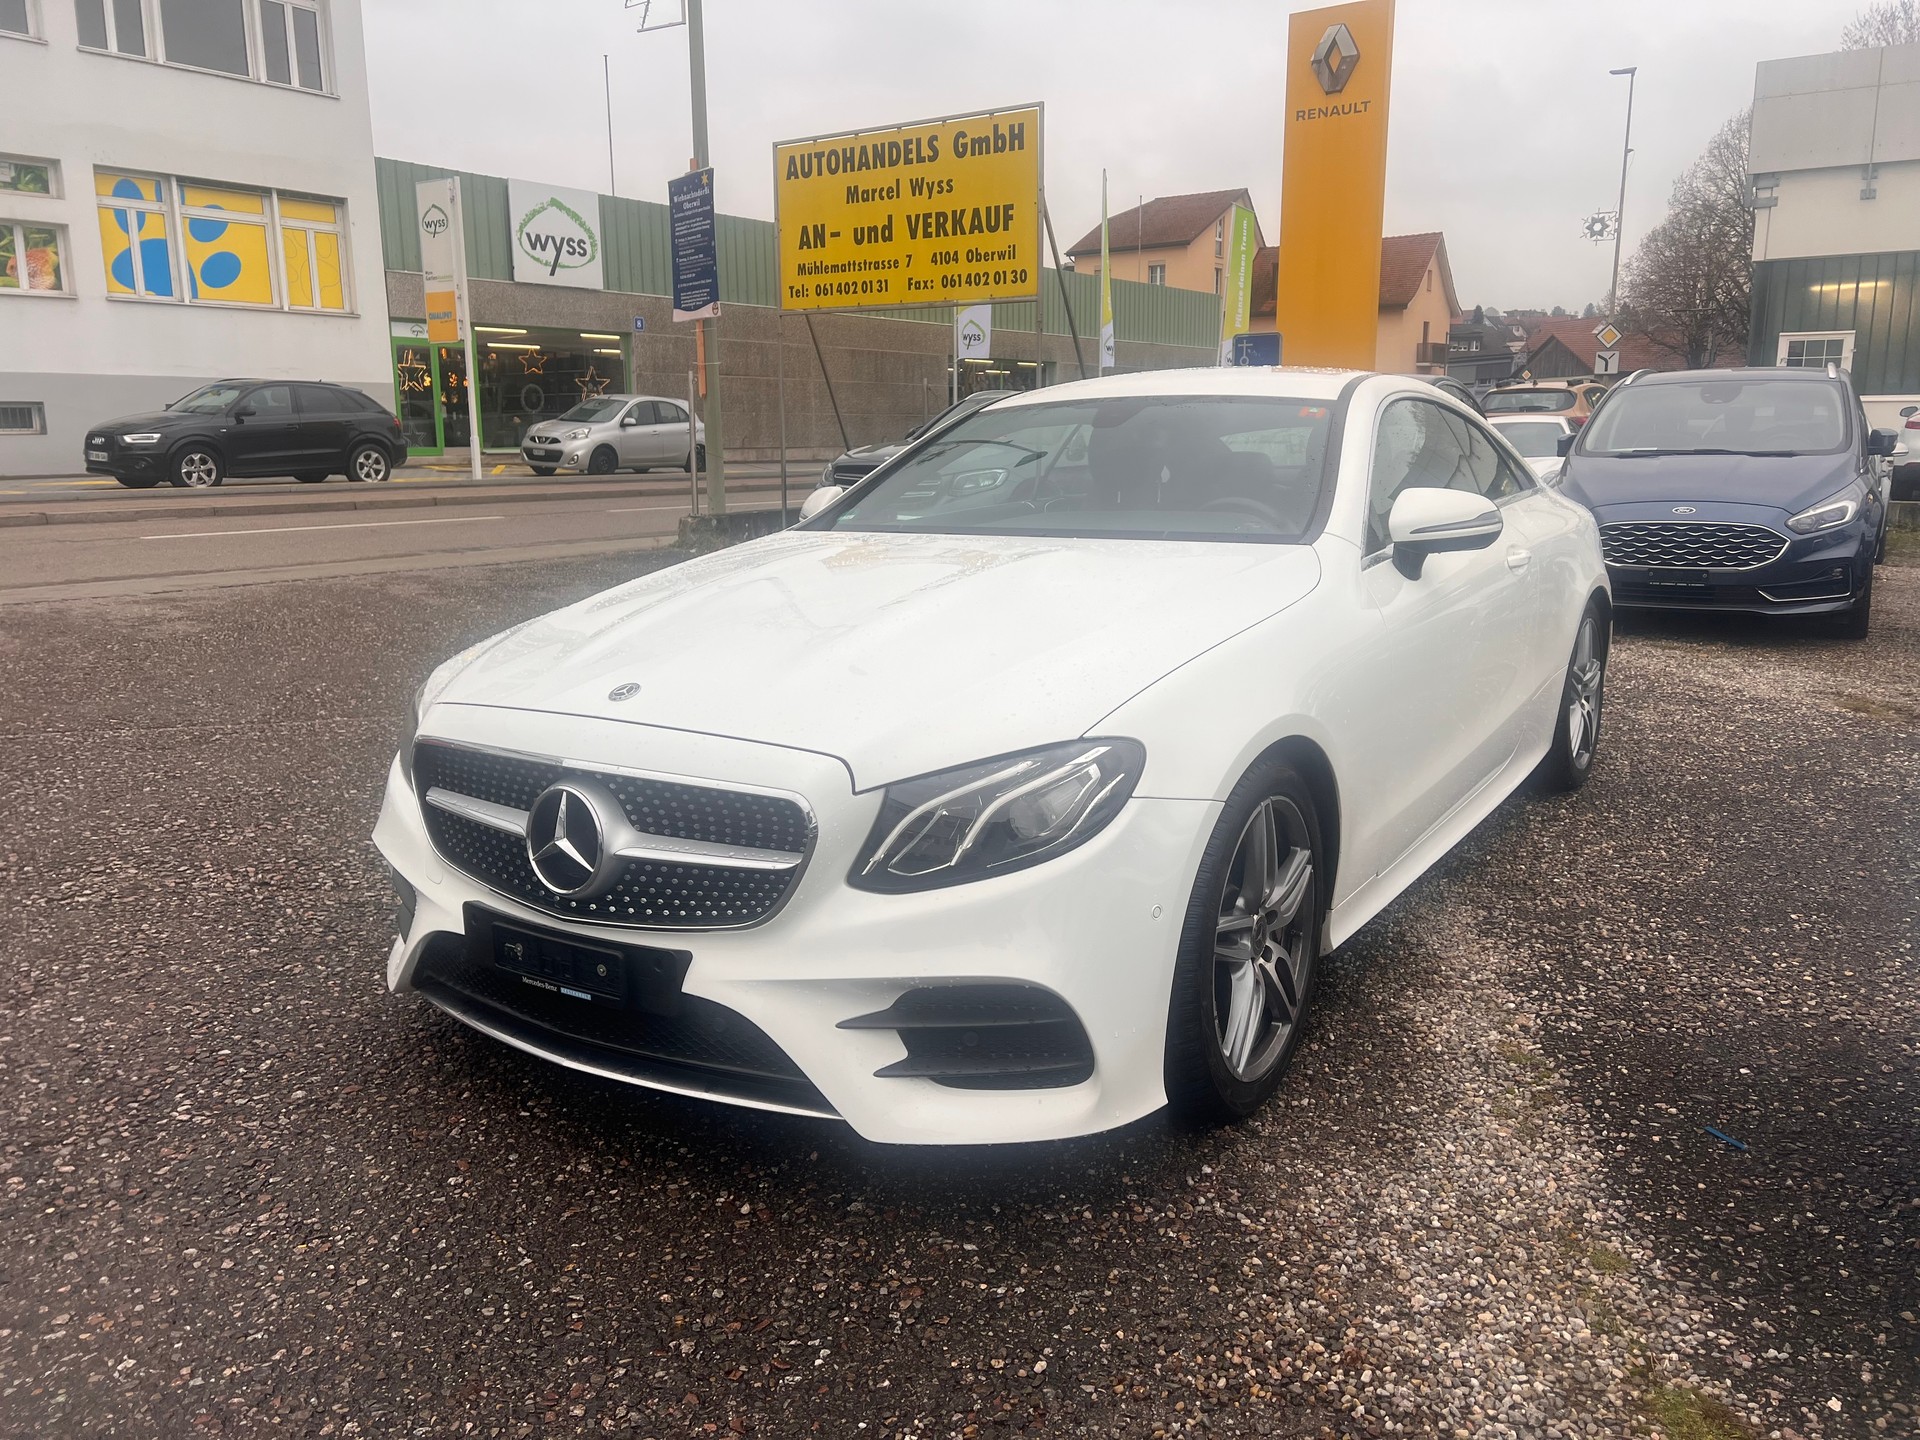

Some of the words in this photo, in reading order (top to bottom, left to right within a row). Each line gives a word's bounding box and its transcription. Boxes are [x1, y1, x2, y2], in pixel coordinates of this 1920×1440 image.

[1295, 100, 1371, 121] RENAULT
[786, 134, 940, 180] AUTOHANDELS
[953, 122, 1025, 159] GmbH
[846, 178, 900, 204] Marcel
[909, 177, 954, 200] Wyss
[424, 218, 446, 239] wyss
[853, 214, 893, 245] und
[906, 203, 1015, 240] VERKAUF
[1240, 217, 1248, 252] Traum.
[525, 232, 588, 277] wyss
[797, 258, 900, 277] Mühlemattstrasse
[905, 254, 913, 268] 7
[930, 250, 959, 266] 4104
[966, 244, 1016, 263] Oberwil
[1238, 253, 1246, 289] deinen
[788, 283, 809, 298] Tel:
[907, 277, 934, 291] Fax:
[1234, 290, 1244, 329] Pflanze
[962, 333, 982, 350] wyss
[521, 975, 558, 992] Mercedes-Benz
